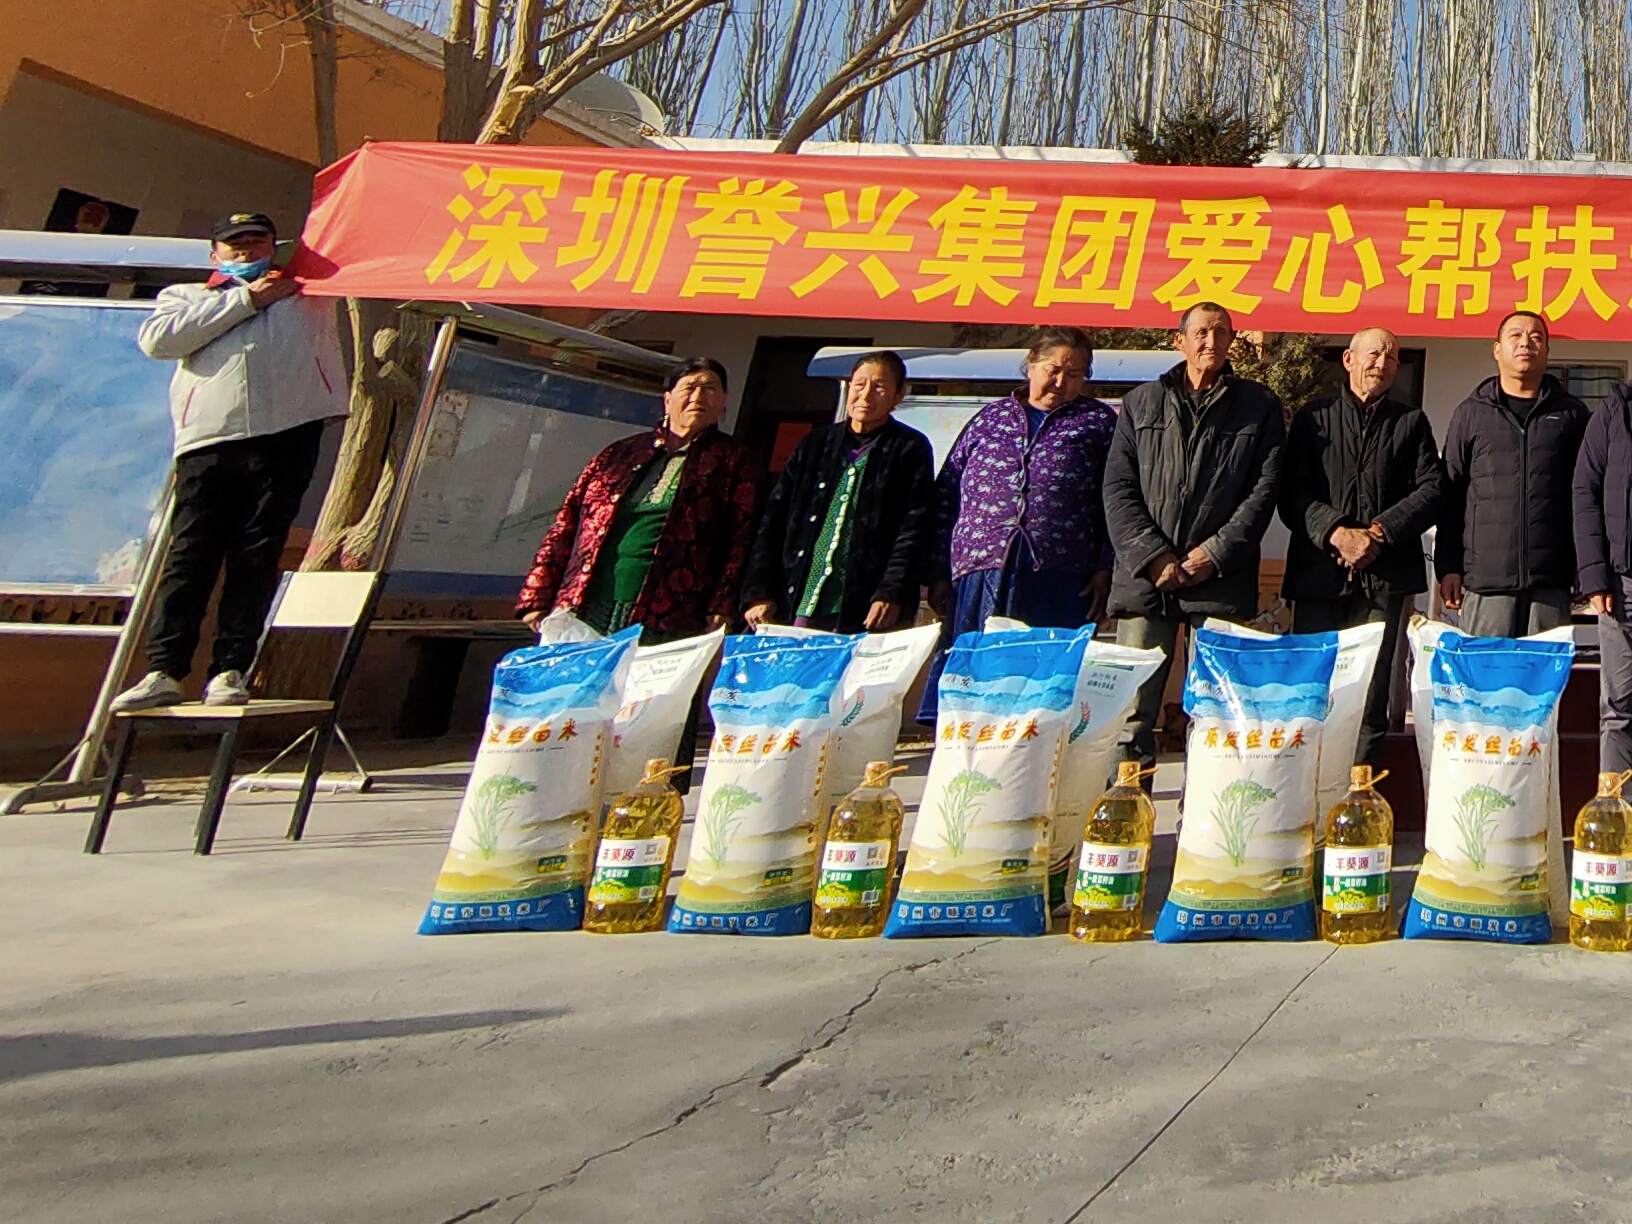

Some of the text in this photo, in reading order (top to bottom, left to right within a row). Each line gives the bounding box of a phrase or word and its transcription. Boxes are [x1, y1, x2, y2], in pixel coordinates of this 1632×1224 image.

[1336, 856, 1370, 871] 丰葵源
[1585, 862, 1618, 876] 丰葵源
